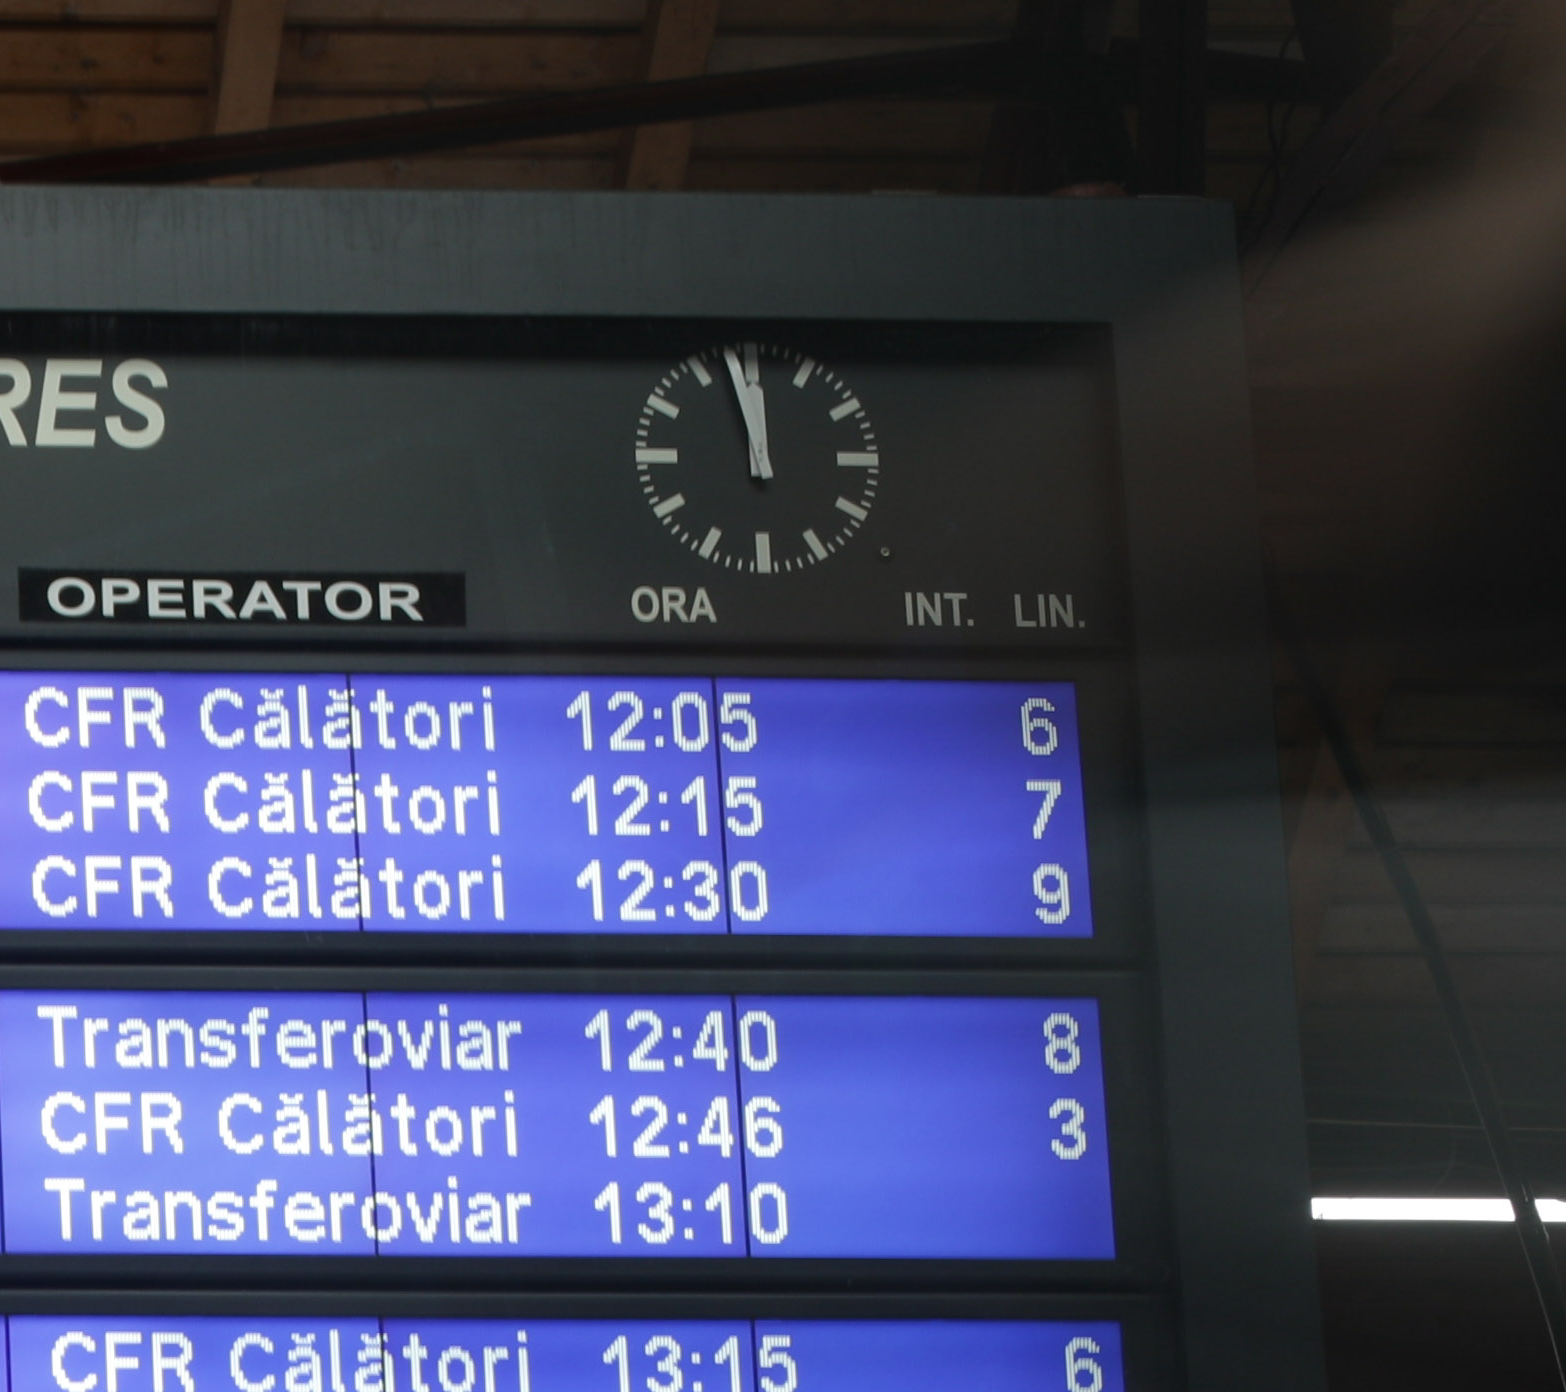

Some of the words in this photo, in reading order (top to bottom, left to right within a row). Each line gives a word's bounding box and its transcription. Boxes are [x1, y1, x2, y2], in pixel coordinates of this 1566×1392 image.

[44, 576, 425, 622] OPERATOR
[629, 585, 717, 625] ORA
[904, 590, 976, 628] INT.
[1013, 593, 1087, 630] LIN.
[24, 686, 166, 748] CFR
[200, 685, 495, 750] Călători
[567, 691, 757, 751] 12:05
[1021, 698, 1057, 755] 6
[28, 770, 170, 833] CFR
[204, 768, 500, 835] Călători
[571, 775, 763, 836] 12:15
[1027, 781, 1061, 839] 7
[32, 855, 174, 917] CFR
[208, 853, 505, 920] Călători
[576, 859, 768, 921] 12:30
[1033, 864, 1070, 924] 9
[37, 1004, 521, 1070] Transferoviar
[585, 1011, 777, 1071] 12:40
[1044, 1014, 1080, 1074] 8
[40, 1091, 184, 1155] CFR
[218, 1089, 517, 1157] Călători
[589, 1095, 783, 1158] 12:46
[1049, 1099, 1087, 1160] 3
